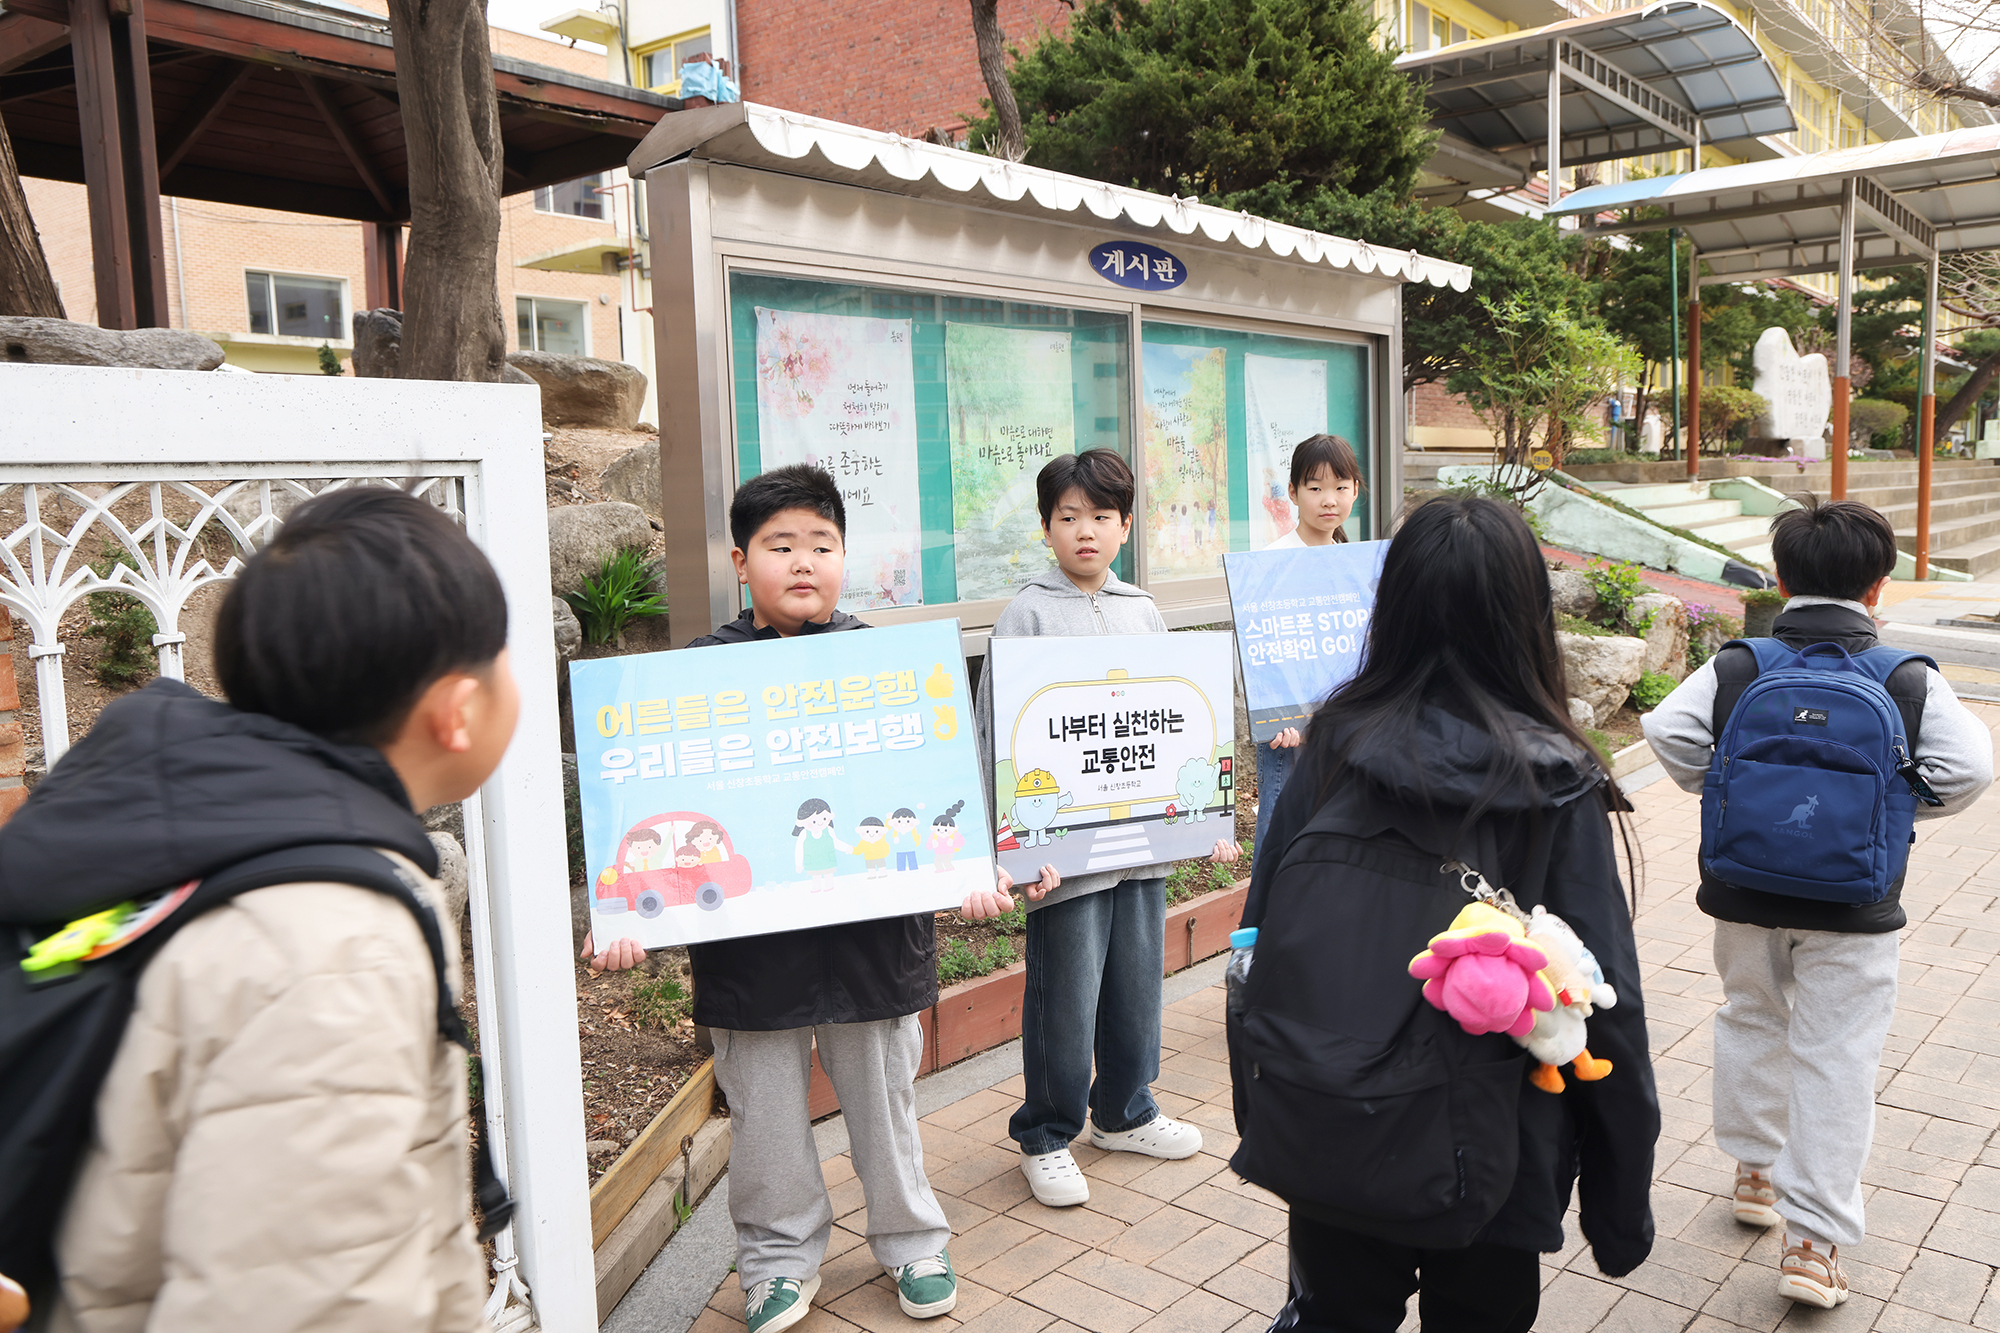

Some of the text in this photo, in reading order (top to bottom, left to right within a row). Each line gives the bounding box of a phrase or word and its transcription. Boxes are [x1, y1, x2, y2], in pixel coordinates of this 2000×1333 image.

[1101, 249, 1177, 283] 게시판
[864, 420, 890, 431] 바라보기
[1000, 425, 1053, 441] 마음으로 대하면
[979, 441, 1053, 470] 마음으로 돌아와요
[1166, 435, 1186, 455] 마음을
[840, 449, 884, 476] 존중하는
[1242, 592, 1361, 613] 서울 신창초등학교 교통안전캠페인
[1245, 613, 1314, 640] 스마트폰
[1247, 634, 1357, 666] 안전확인 GO!
[596, 669, 920, 739] 어른들은 안전운행
[1049, 708, 1185, 743] 나부터 실천하는
[599, 712, 926, 785] 우리들은 안전보행
[1081, 743, 1156, 774] 교통안전
[706, 765, 846, 791] 서울 신창초등학교 교통안전캠페인
[1771, 826, 1815, 840] KANGOL
